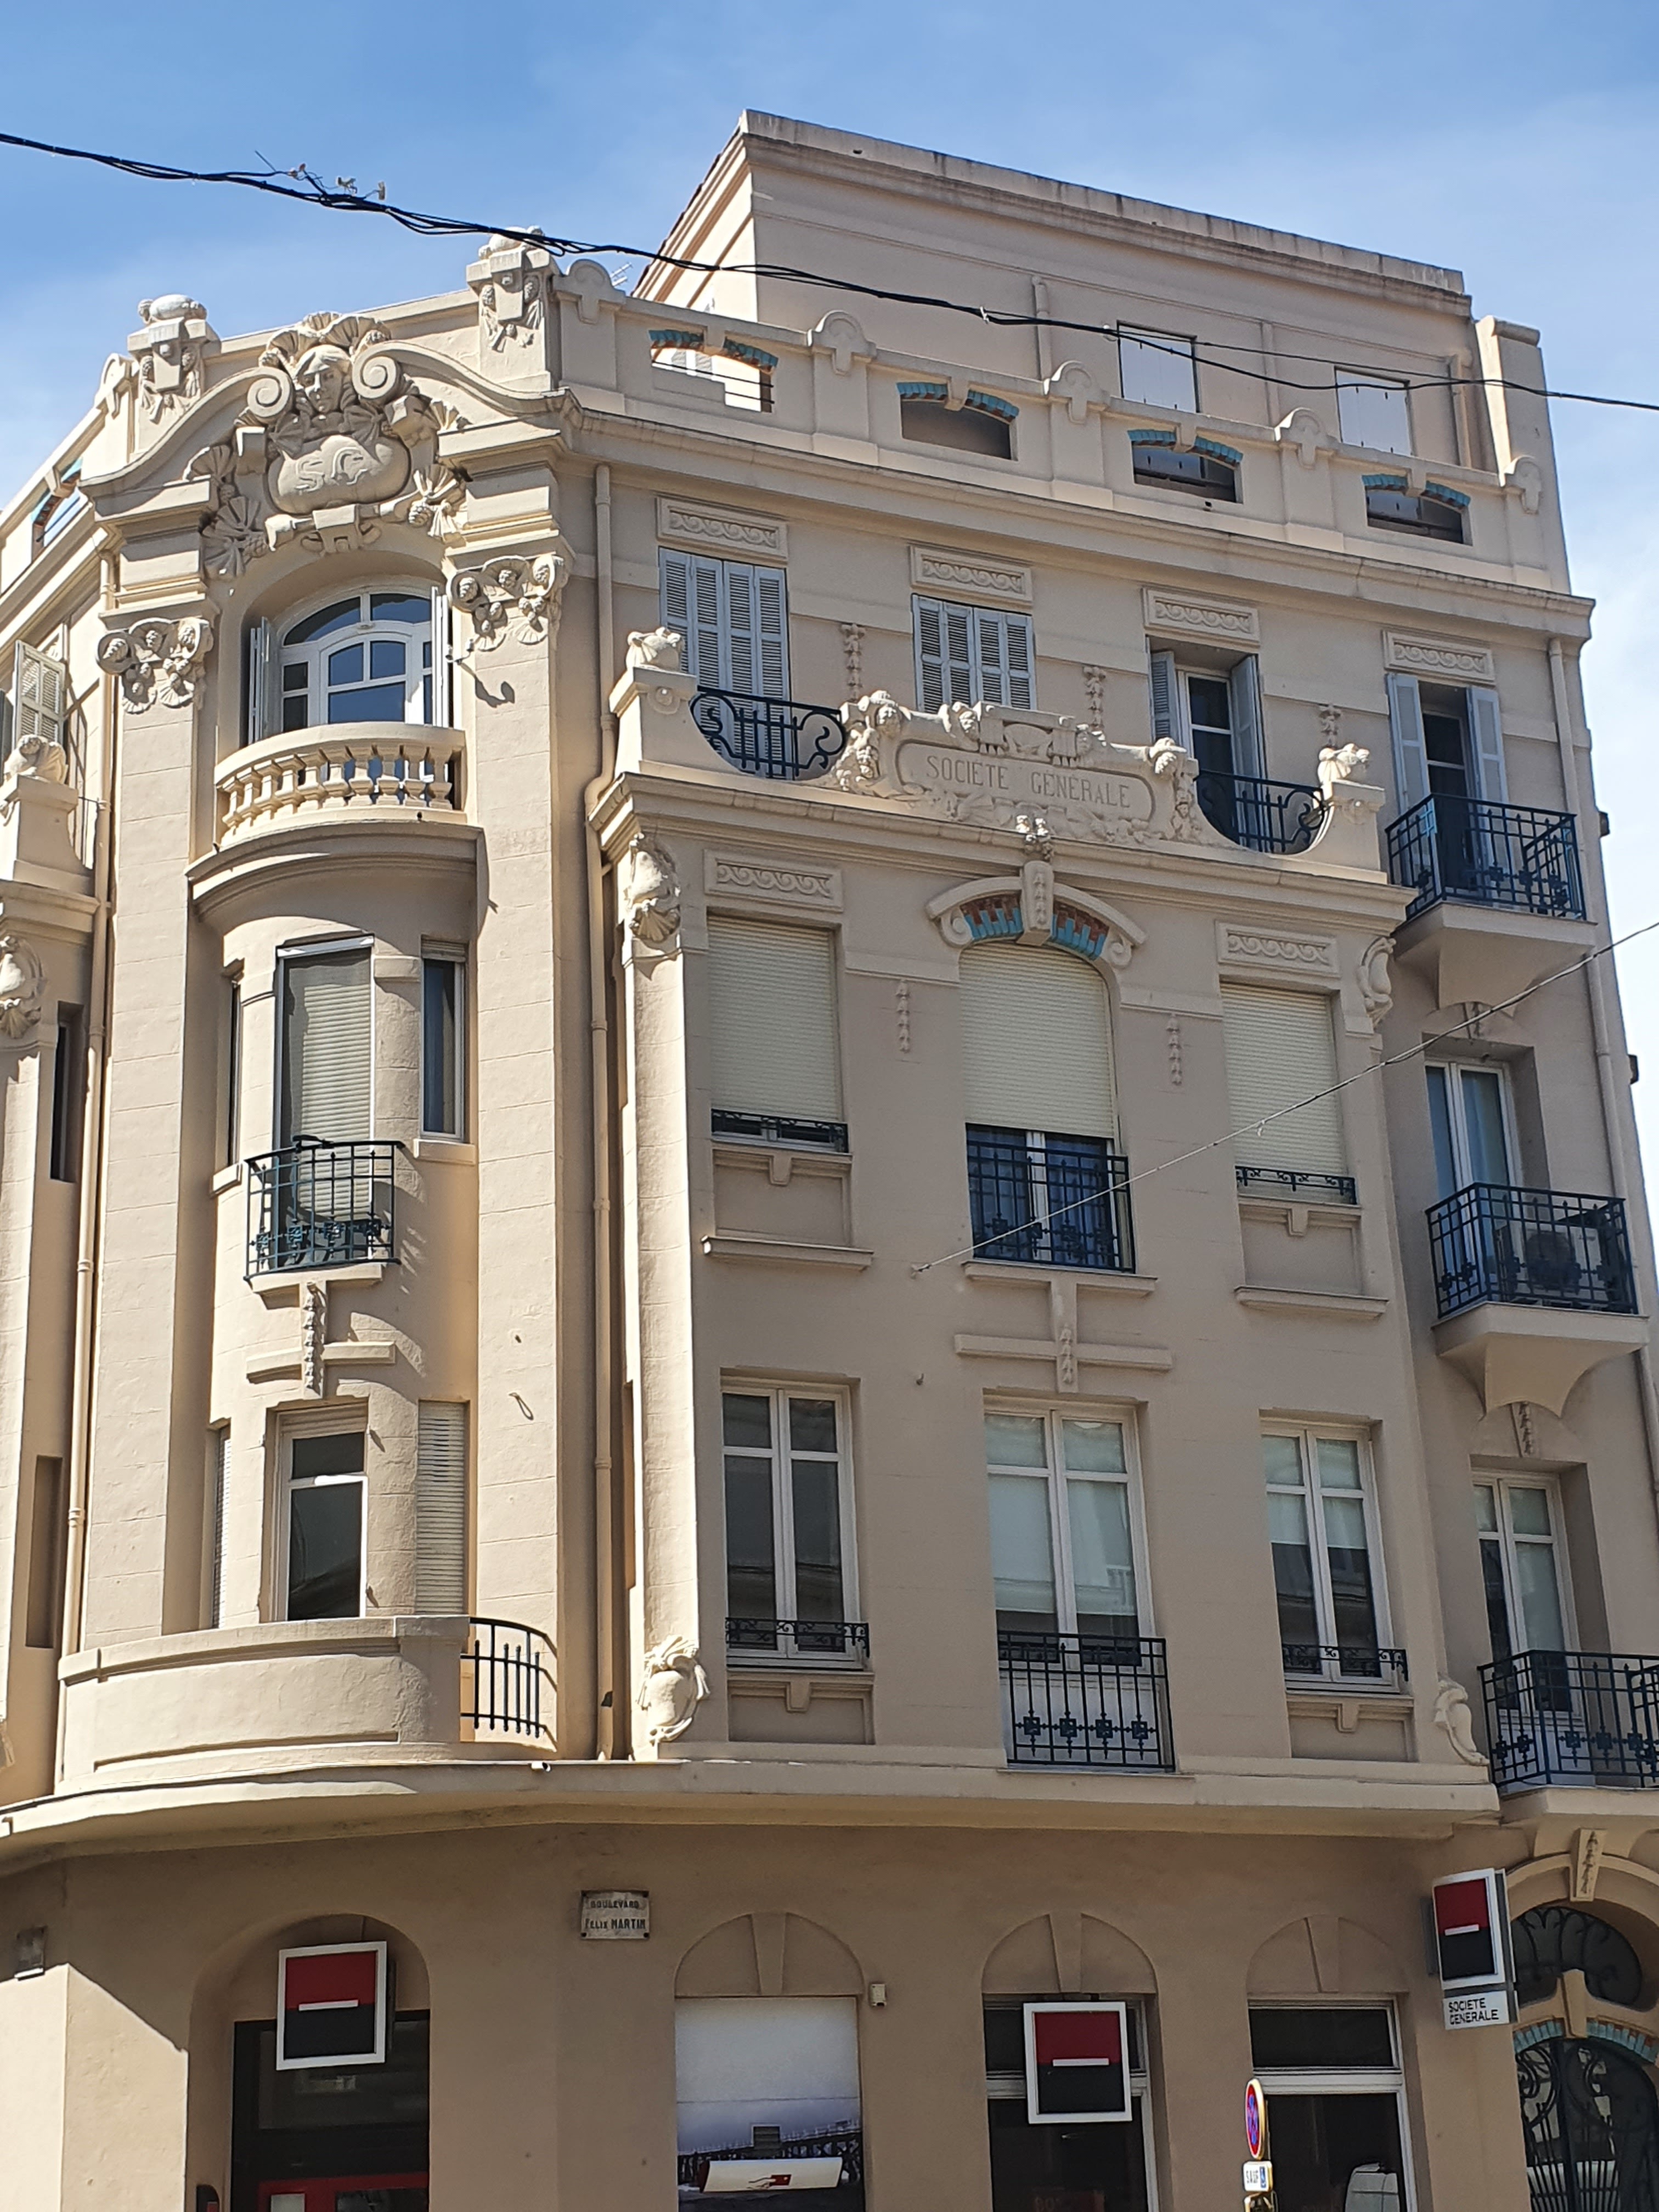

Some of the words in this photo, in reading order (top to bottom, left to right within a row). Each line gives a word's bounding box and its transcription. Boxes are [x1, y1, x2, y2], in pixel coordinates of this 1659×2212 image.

[590, 1900, 640, 1909] BOULEVARD
[611, 1918, 646, 1929] MARTIN
[1448, 1997, 1486, 2013] SOCIETE
[1450, 2009, 1499, 2025] GENERALE
